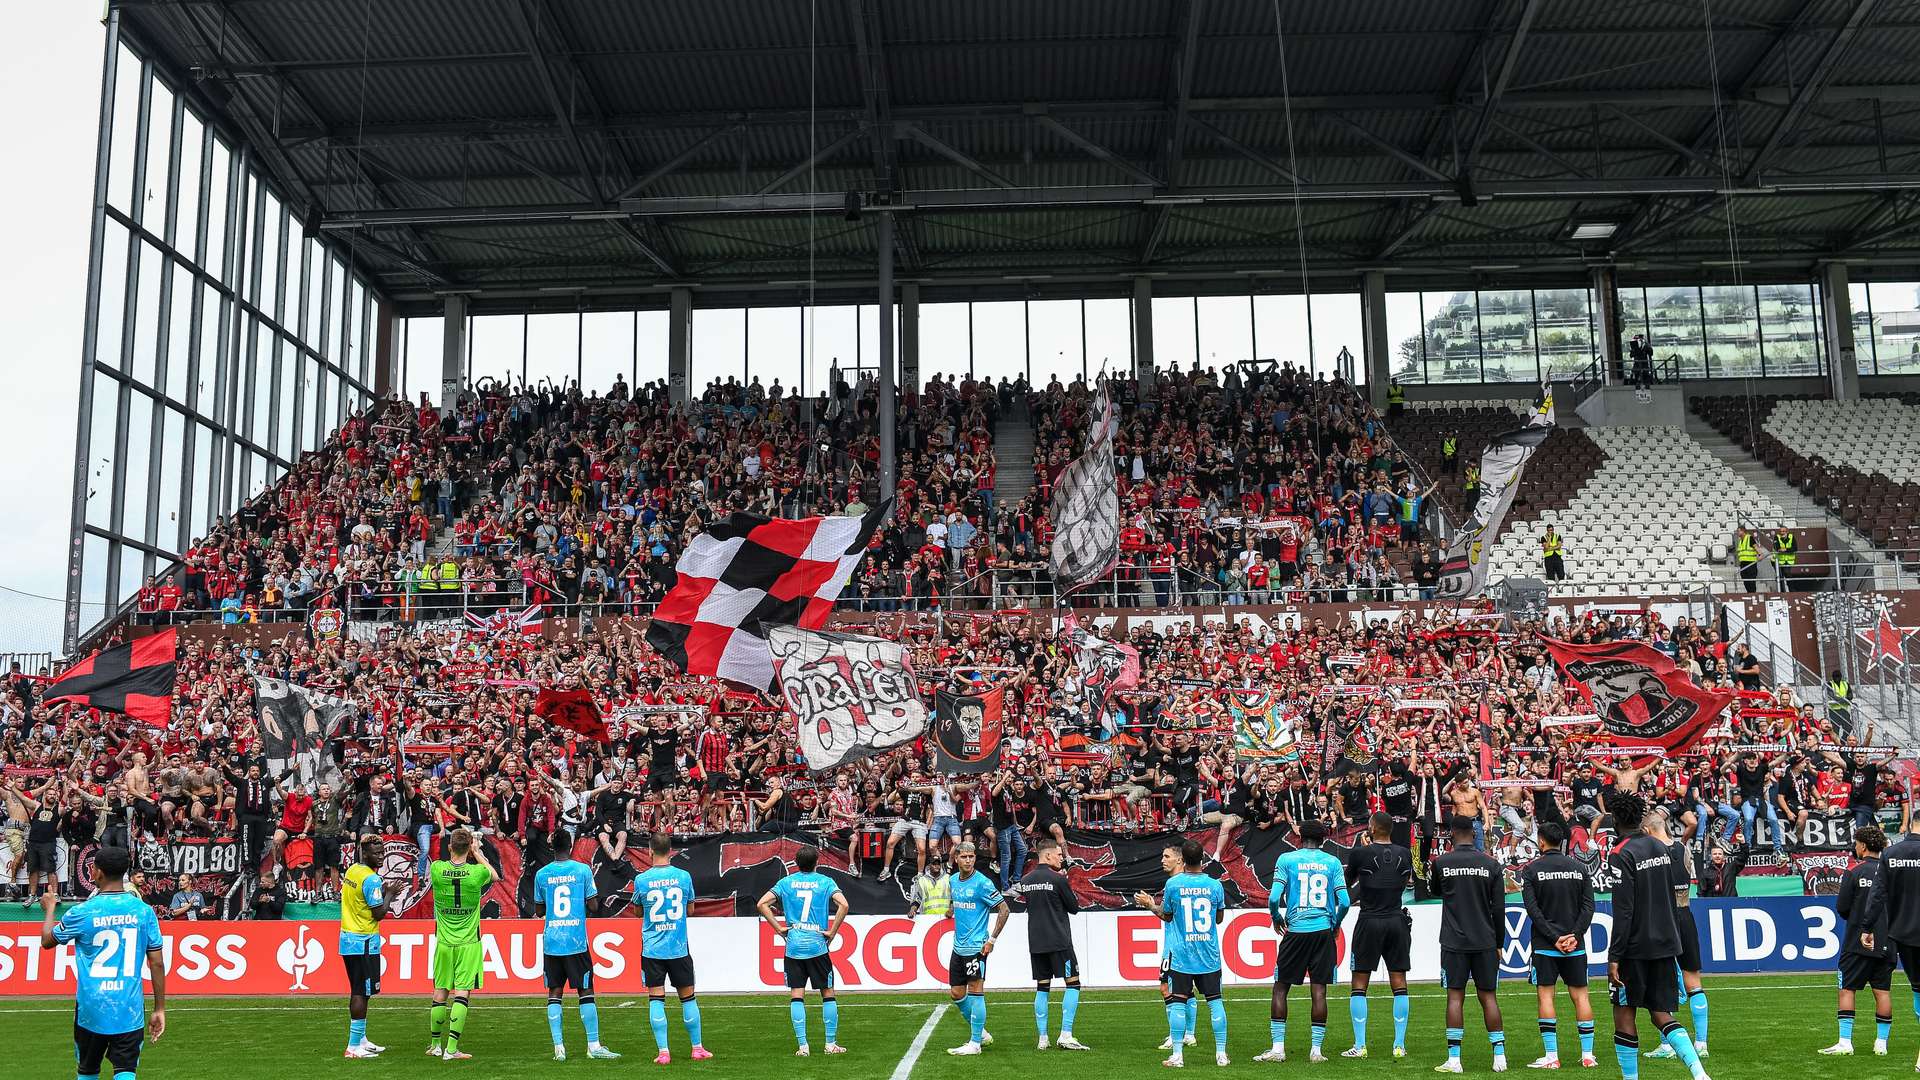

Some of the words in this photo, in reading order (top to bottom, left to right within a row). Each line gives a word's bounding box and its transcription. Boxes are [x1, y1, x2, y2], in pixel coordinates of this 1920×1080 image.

[171, 843, 236, 874] YBL98
[1443, 866, 1489, 877] Barmenia
[1888, 857, 1920, 868] Barme
[1297, 872, 1328, 908] 18
[1537, 870, 1583, 881] Barmenia
[451, 878, 461, 909] 1
[553, 885, 571, 918] 6
[646, 887, 684, 923] 23
[796, 890, 813, 922] 7
[1180, 897, 1212, 933] 13
[1185, 932, 1213, 942] ARTHUR
[1708, 905, 1841, 962] ID.3
[88, 927, 139, 978] 21
[965, 958, 980, 976] 25
[99, 980, 124, 991] ADLI
